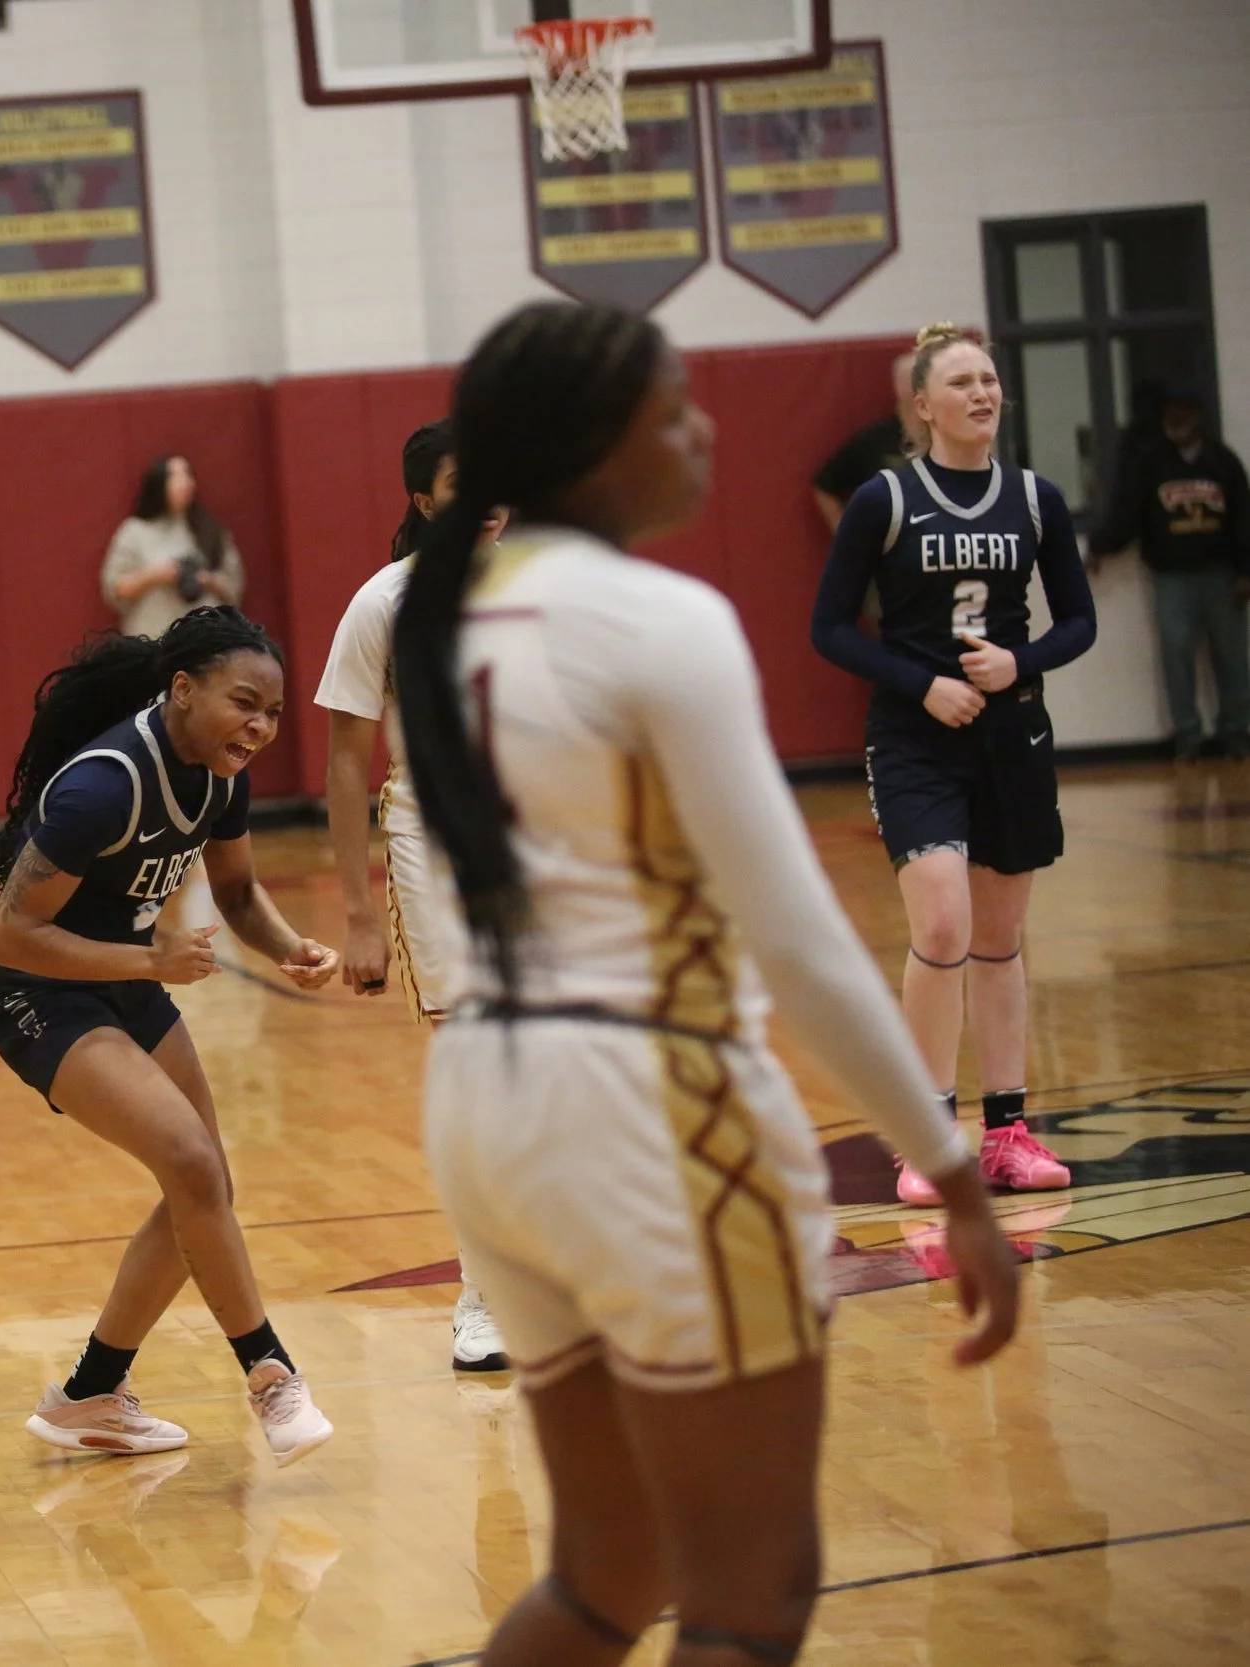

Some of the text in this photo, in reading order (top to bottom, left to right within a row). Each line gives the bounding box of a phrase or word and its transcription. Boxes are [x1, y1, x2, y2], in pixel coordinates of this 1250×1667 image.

[921, 533, 1020, 572] ELBERT
[951, 580, 989, 641] 2
[126, 838, 209, 899] ELBER
